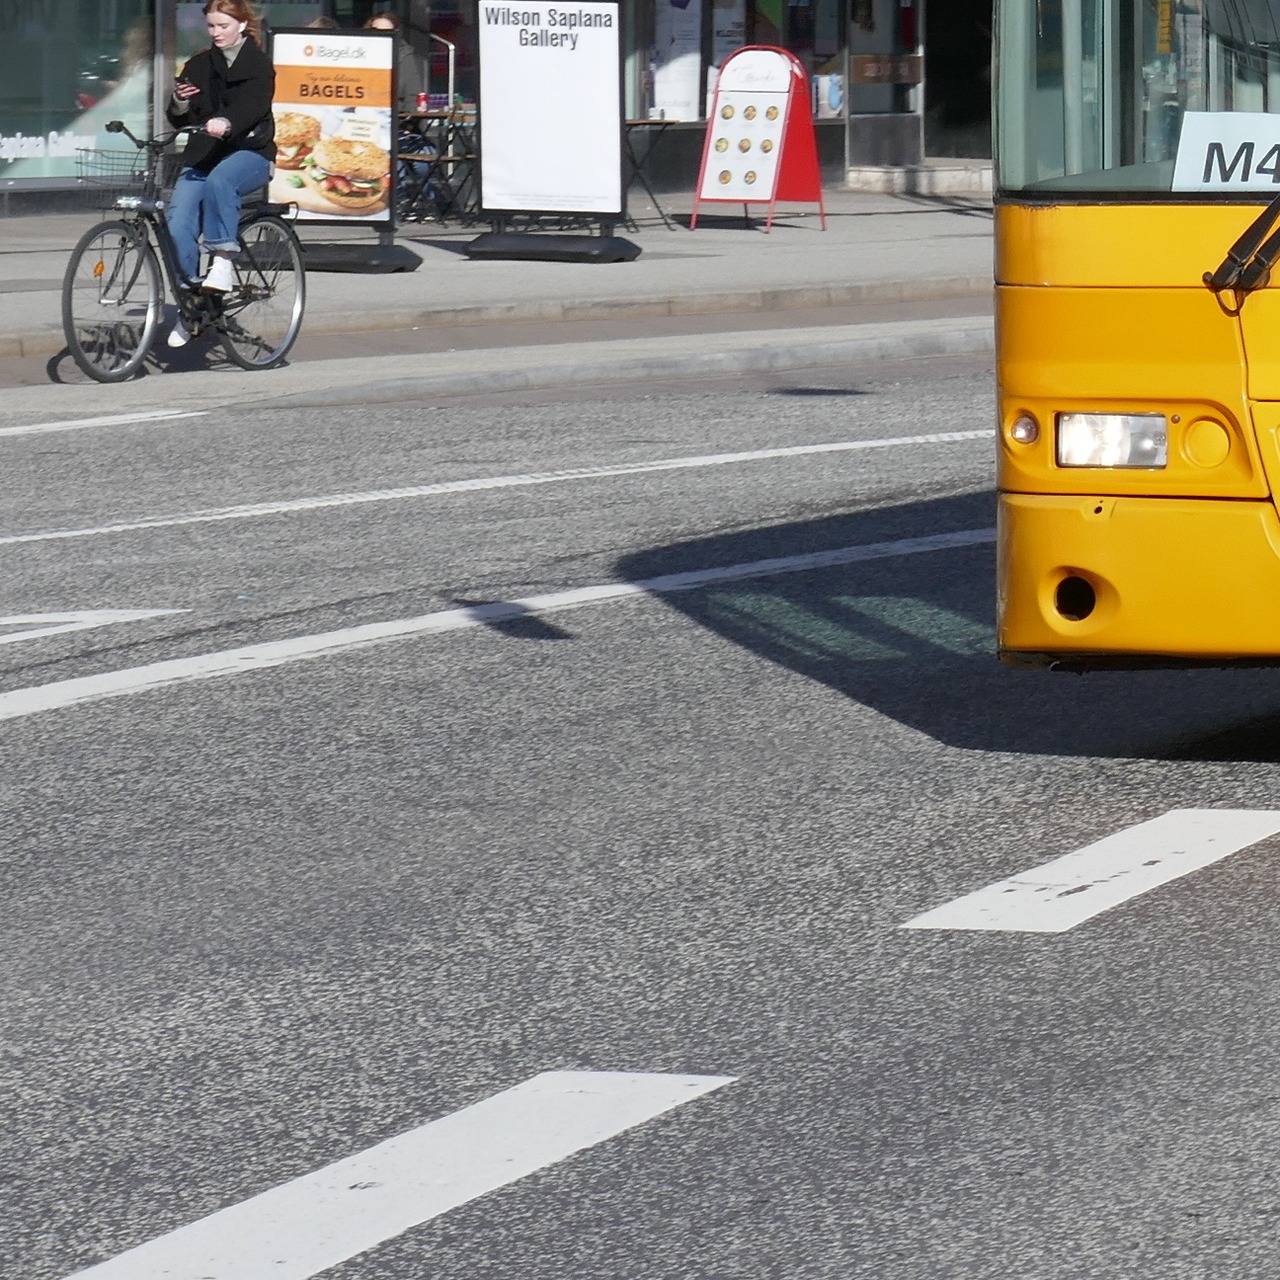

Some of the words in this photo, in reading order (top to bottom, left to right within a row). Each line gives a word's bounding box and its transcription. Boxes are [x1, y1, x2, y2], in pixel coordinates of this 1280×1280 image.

[485, 7, 541, 26] Wilson
[547, 8, 613, 30] Saplana
[519, 28, 578, 51] Gallery
[299, 83, 364, 99] BAGELS
